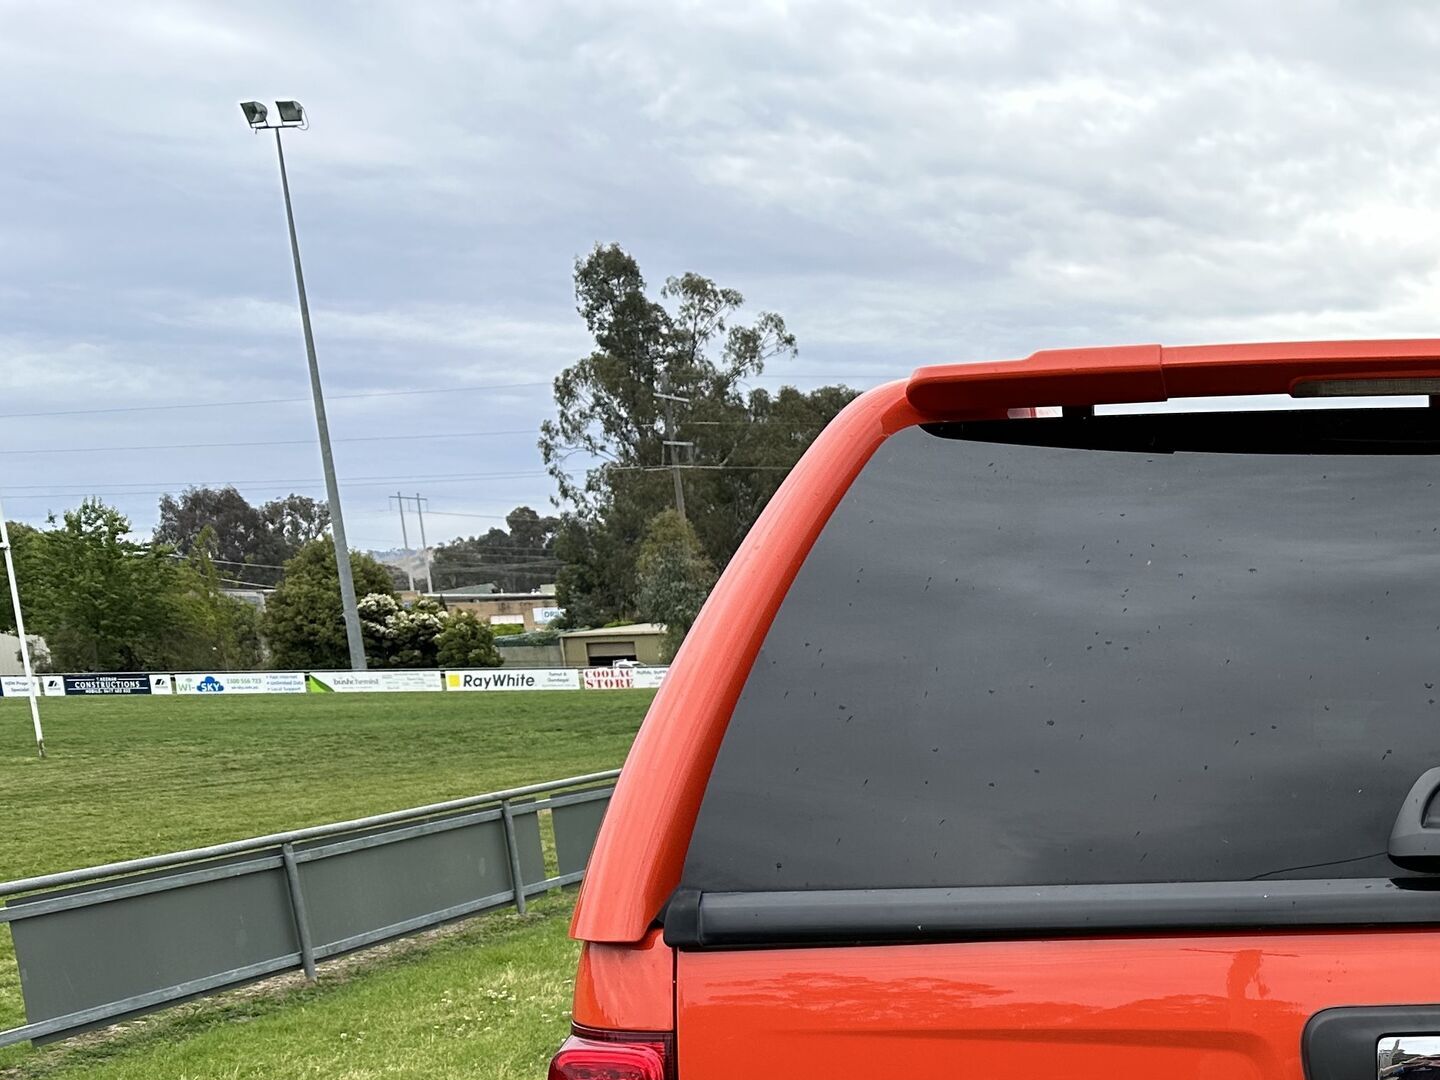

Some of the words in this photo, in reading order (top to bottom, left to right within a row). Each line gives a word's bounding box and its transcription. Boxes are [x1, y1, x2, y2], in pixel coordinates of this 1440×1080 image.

[585, 669, 633, 678] COOLAC
[463, 674, 535, 689] RayWhite
[586, 679, 634, 688] STORE
